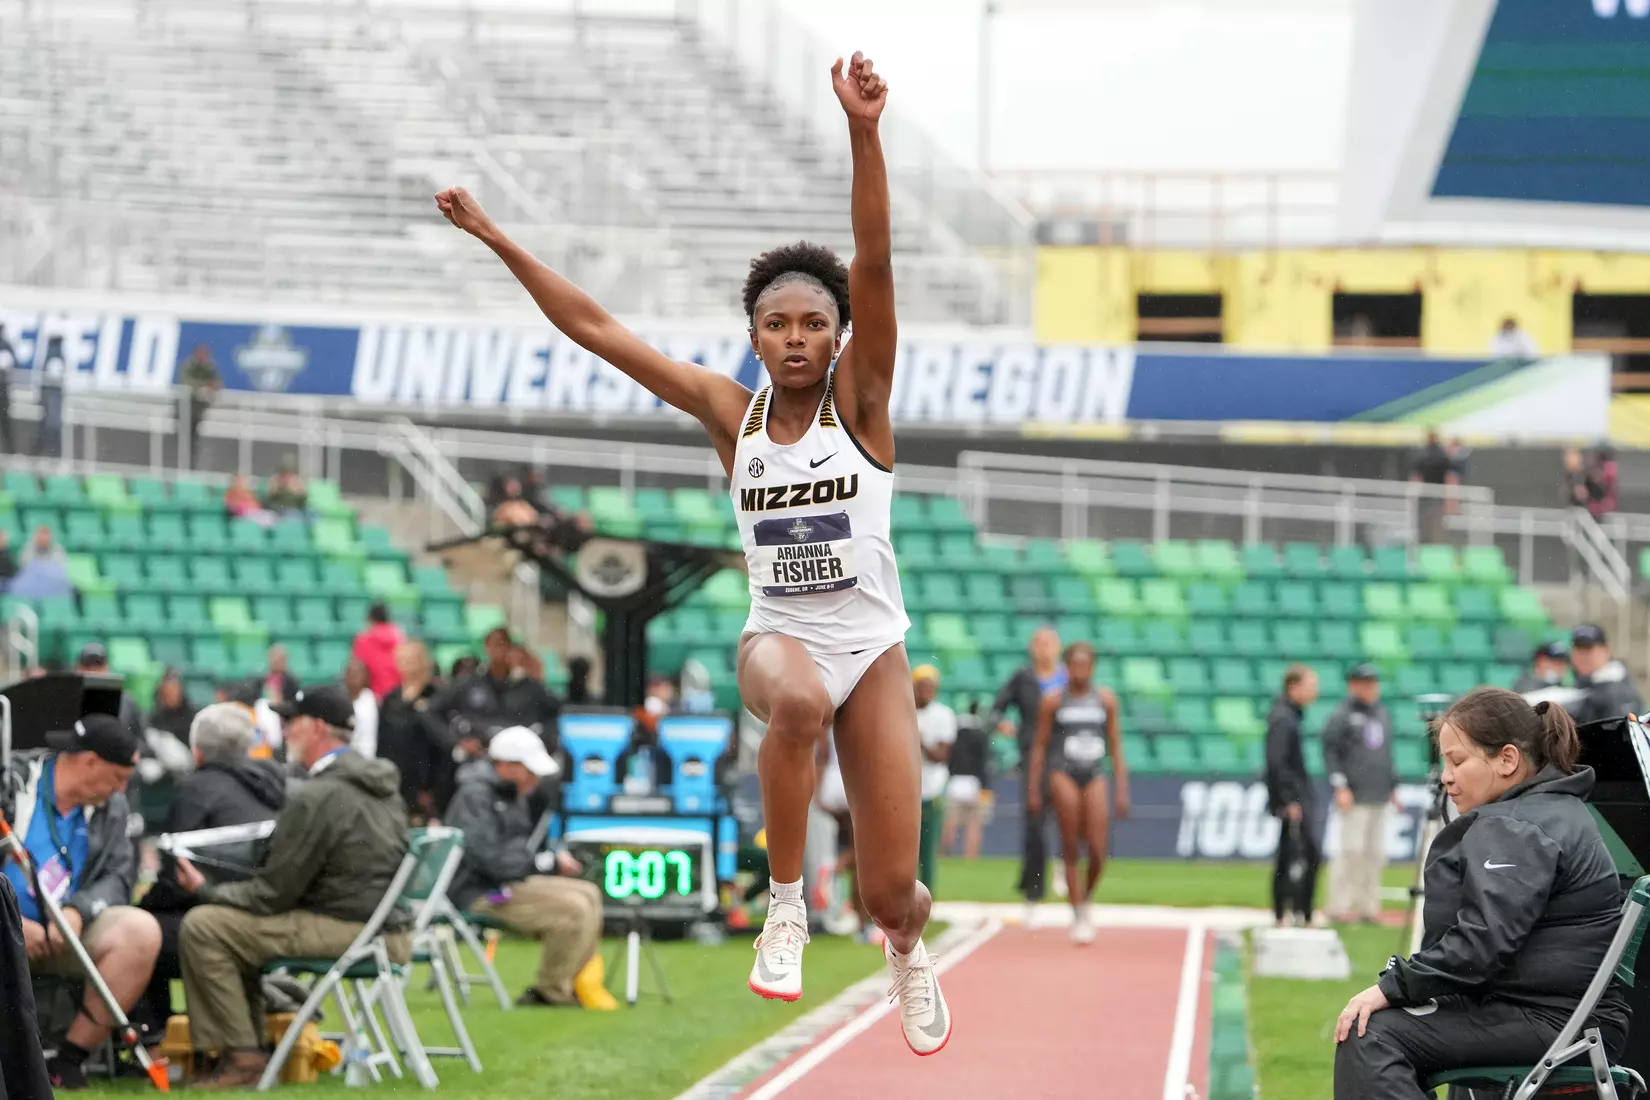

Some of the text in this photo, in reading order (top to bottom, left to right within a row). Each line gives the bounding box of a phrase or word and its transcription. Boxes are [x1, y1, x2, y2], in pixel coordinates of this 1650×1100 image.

[889, 342, 1139, 420] REGON
[749, 458, 764, 477] SEC
[740, 473, 859, 512] MIZZOU
[777, 543, 833, 560] ARIANNA
[772, 557, 844, 583] FISHER
[605, 850, 692, 898] 0:07
